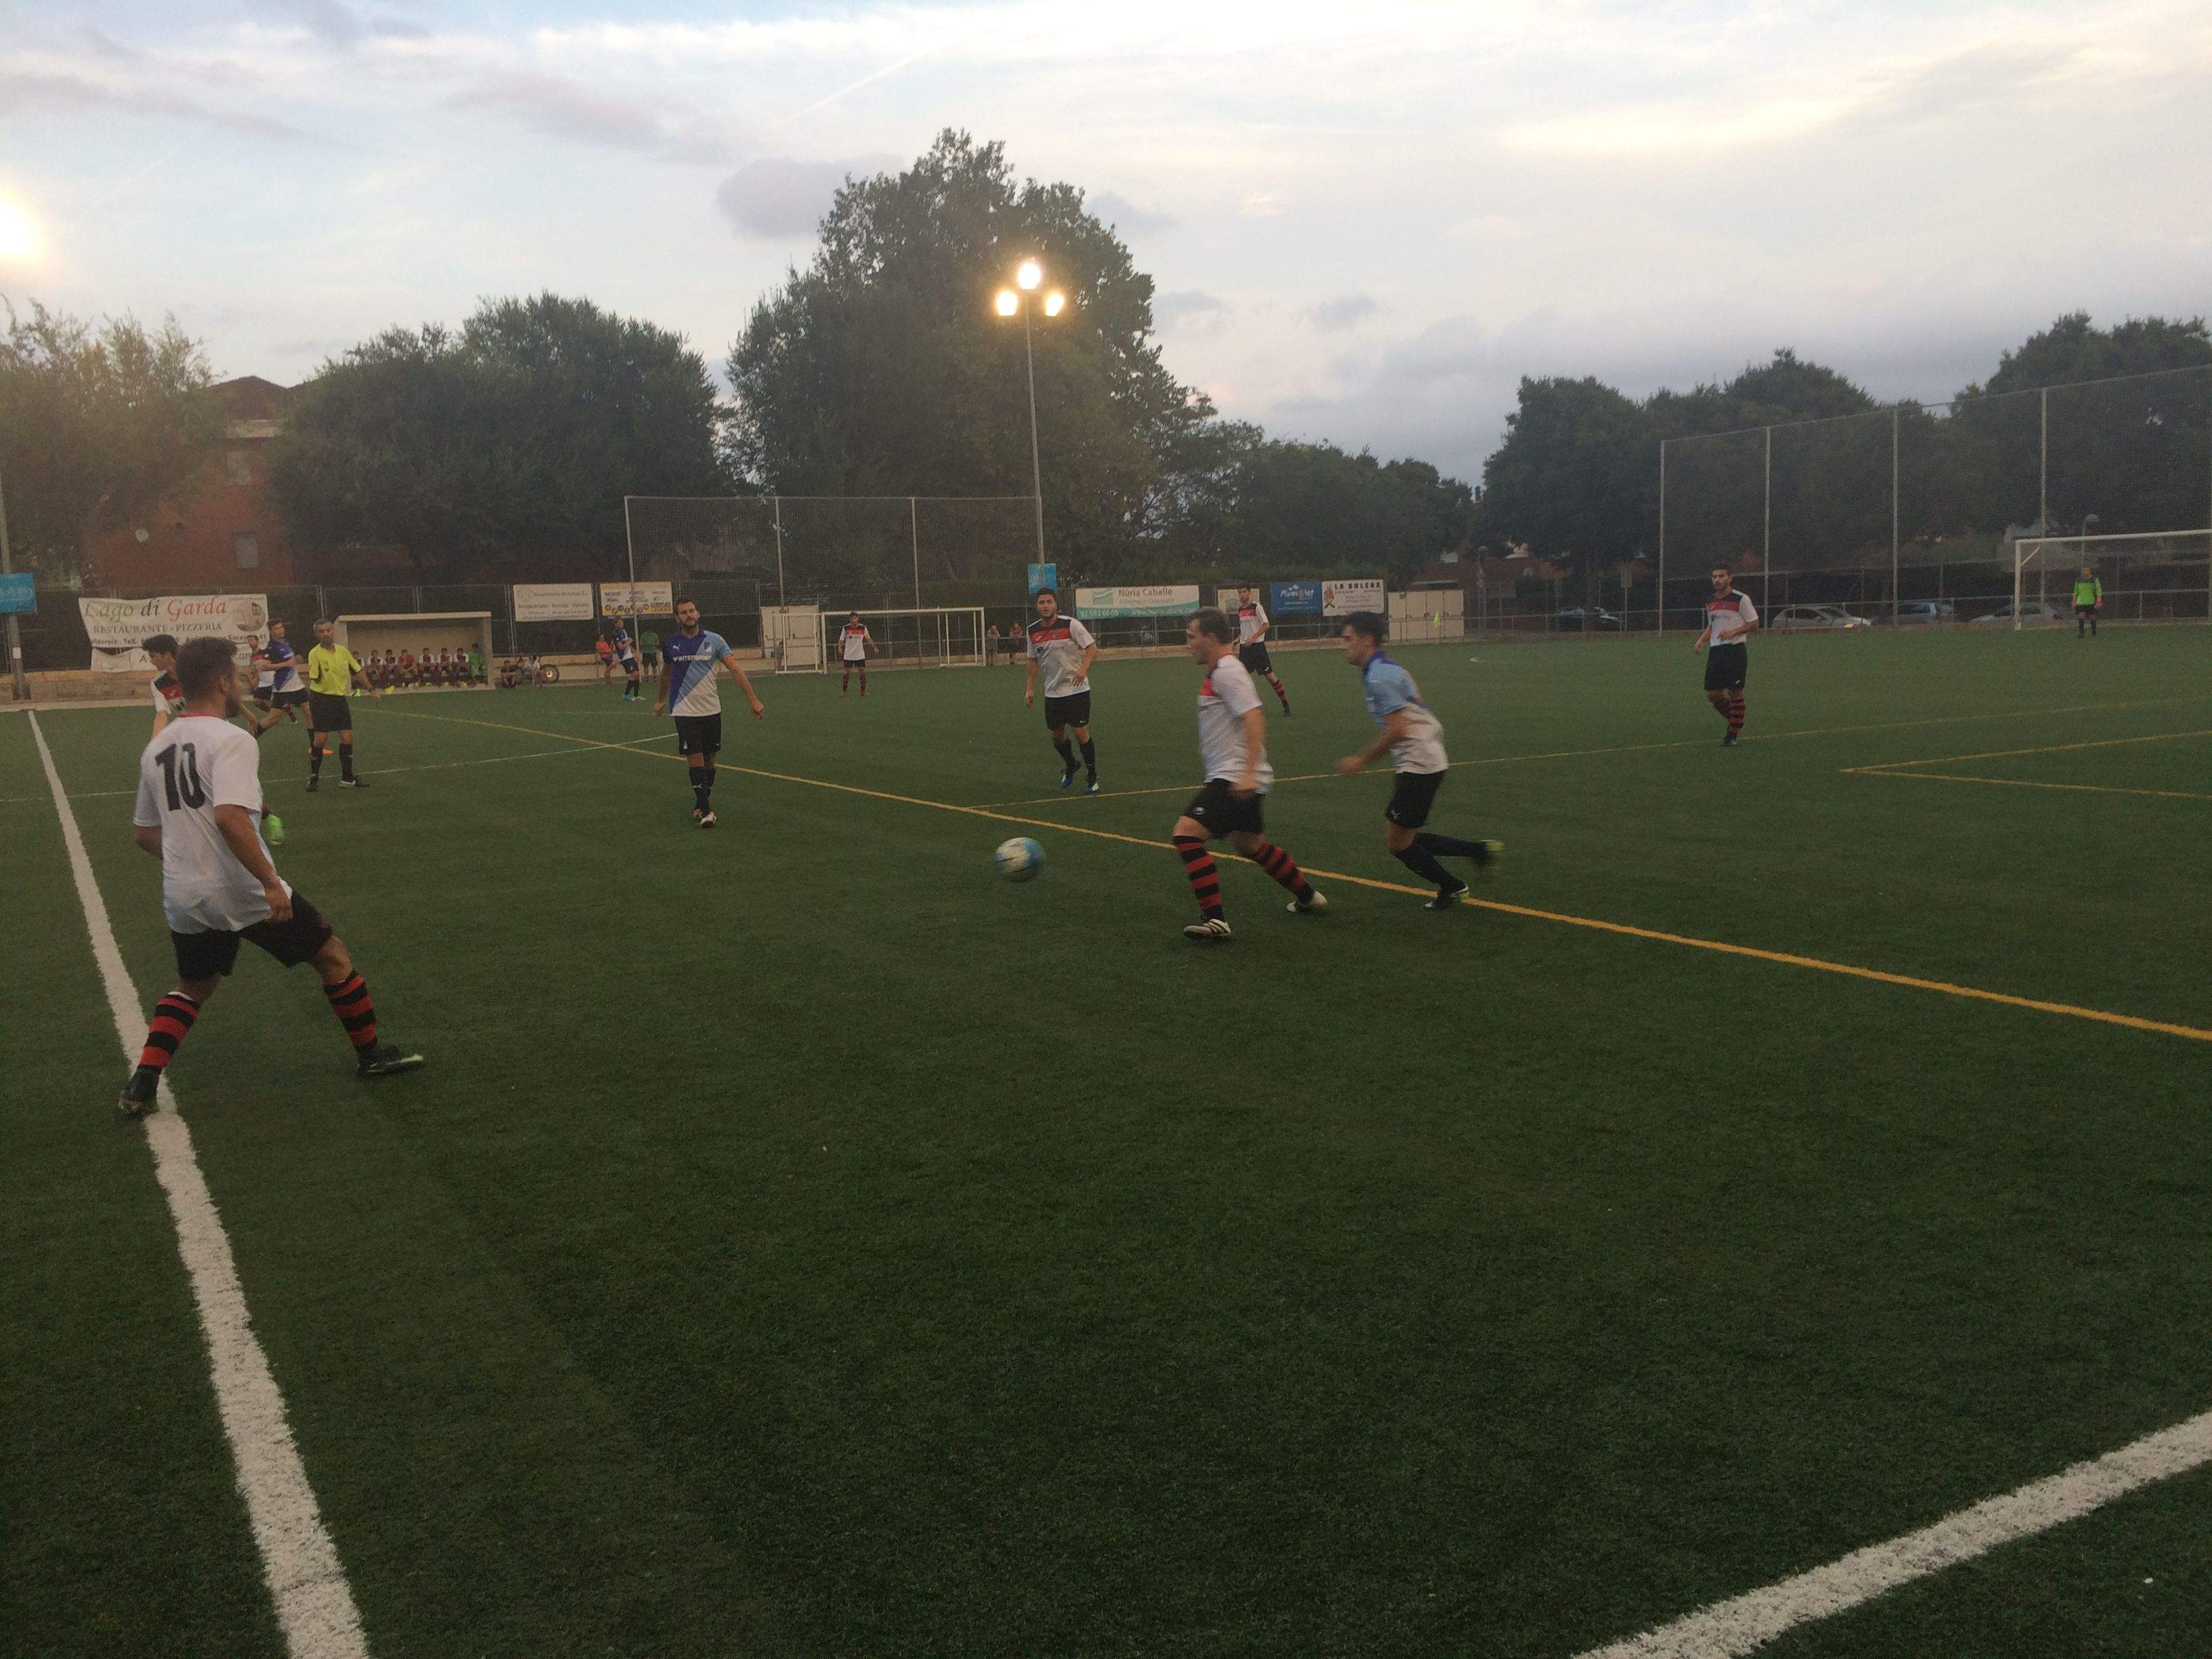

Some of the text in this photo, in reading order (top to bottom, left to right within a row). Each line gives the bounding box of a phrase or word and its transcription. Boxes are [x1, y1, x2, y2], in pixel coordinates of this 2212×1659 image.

[1118, 586, 1173, 597] Núria Caballé
[85, 595, 227, 623] Lago di Garda
[93, 622, 222, 634] RESTAURANTE PIZZERIA
[155, 742, 205, 812] 10
